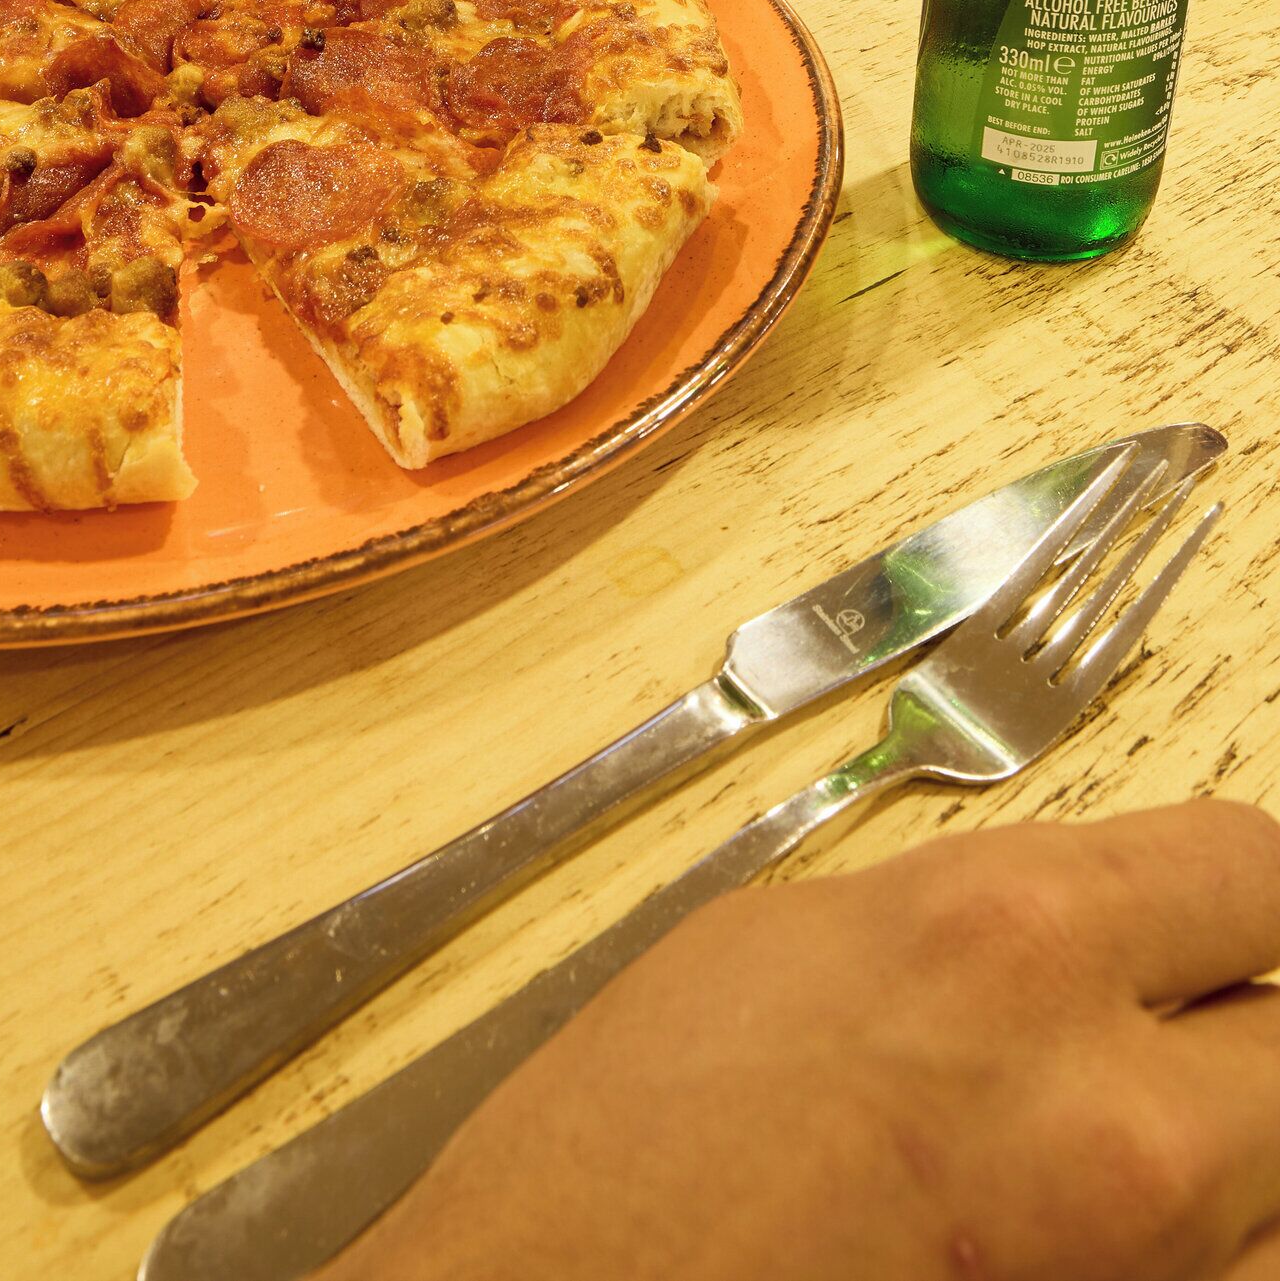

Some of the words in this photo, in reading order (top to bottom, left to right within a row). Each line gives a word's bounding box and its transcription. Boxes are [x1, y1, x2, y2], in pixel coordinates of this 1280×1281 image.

[1030, 9, 1097, 31] NATURAL
[1024, 27, 1086, 42] INGREDIENTS:
[1088, 32, 1119, 43] WATER,
[1120, 26, 1149, 40] MALTED
[1027, 39, 1046, 50] HOP
[1048, 43, 1088, 55] EXTRACT,
[1090, 42, 1127, 54] NATURAL
[1083, 51, 1135, 65] NUTRITIONAL
[1136, 43, 1158, 58] VALUES
[999, 45, 1051, 73] 330ml
[1001, 66, 1018, 78] NOT
[1020, 71, 1044, 83] MORE
[1046, 75, 1069, 86] THAN
[1082, 65, 1115, 76] ENERGY
[1000, 76, 1017, 88] ALC.
[1019, 81, 1046, 94] 0.05%
[1048, 85, 1068, 96] VOL.
[1079, 87, 1092, 96] OF
[1093, 84, 1121, 96] WHICH
[1121, 72, 1156, 92] SATURATES
[1080, 76, 1096, 86] FAT
[995, 86, 1019, 100] STORE
[1021, 92, 1031, 102] IN
[1032, 95, 1038, 103] A
[1040, 96, 1063, 106] COOL
[1078, 88, 1141, 107] CARBOHYDRATES
[1004, 99, 1022, 110] DRY
[1022, 103, 1050, 115] PLACE.
[1077, 107, 1089, 117] OF
[1090, 104, 1117, 116] WHICH
[1118, 97, 1145, 112] SUGARS
[987, 115, 1003, 126] BEST
[1004, 120, 1032, 133] BEFORE
[1032, 126, 1051, 136] END:
[1075, 116, 1110, 127] PROTEIN
[1074, 127, 1094, 137] SALT
[1120, 147, 1142, 160] Widely
[1017, 171, 1054, 184] 08536
[1060, 175, 1073, 184] ROI
[1075, 171, 1112, 184] CONSUMER
[1113, 161, 1141, 179] CARELINE:
